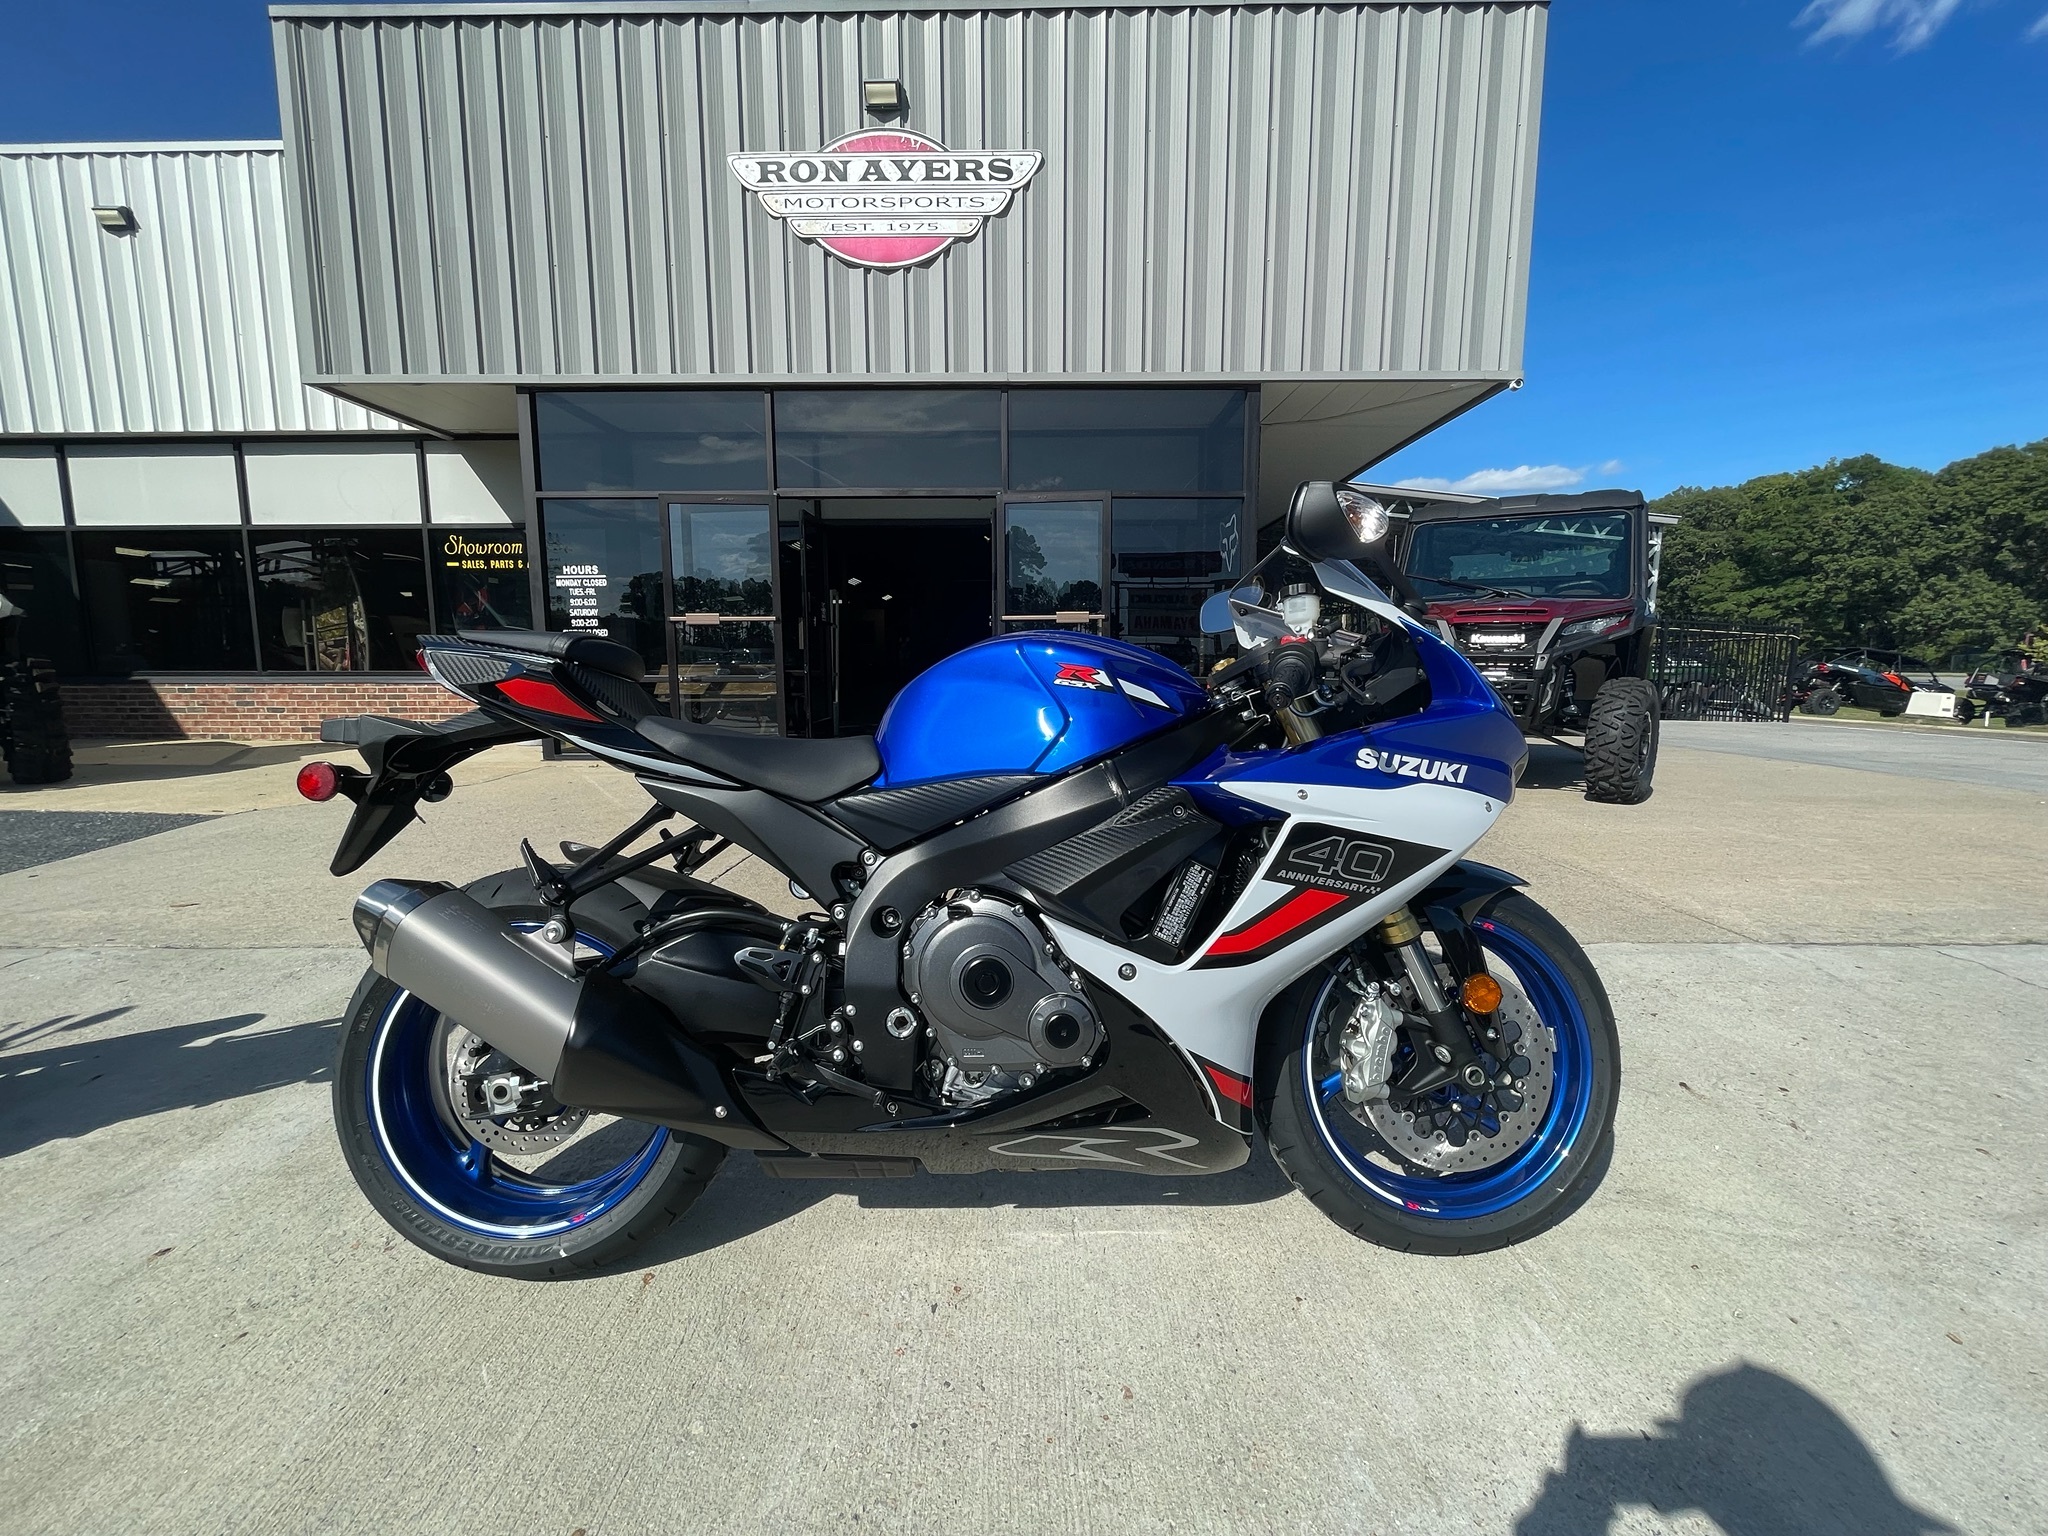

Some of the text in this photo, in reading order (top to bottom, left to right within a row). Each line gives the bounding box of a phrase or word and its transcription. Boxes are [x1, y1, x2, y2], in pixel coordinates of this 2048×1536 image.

[754, 158, 1014, 183] RON AYERS
[783, 196, 986, 210] MOTORSPORTS
[831, 222, 939, 232] EST. 1975
[444, 534, 523, 557] Showroom
[461, 559, 488, 570] SALES,
[490, 559, 514, 569] PARTS
[517, 559, 524, 569] &
[562, 564, 599, 575] HOURS
[555, 578, 608, 587] MONDAY CLOSED
[569, 608, 599, 617] SATURDAY
[570, 618, 599, 627] 9:00-2:00
[1355, 747, 1469, 784] SUZUKI
[1287, 835, 1395, 883] 40
[1276, 869, 1367, 893] ANNIVERSARY
